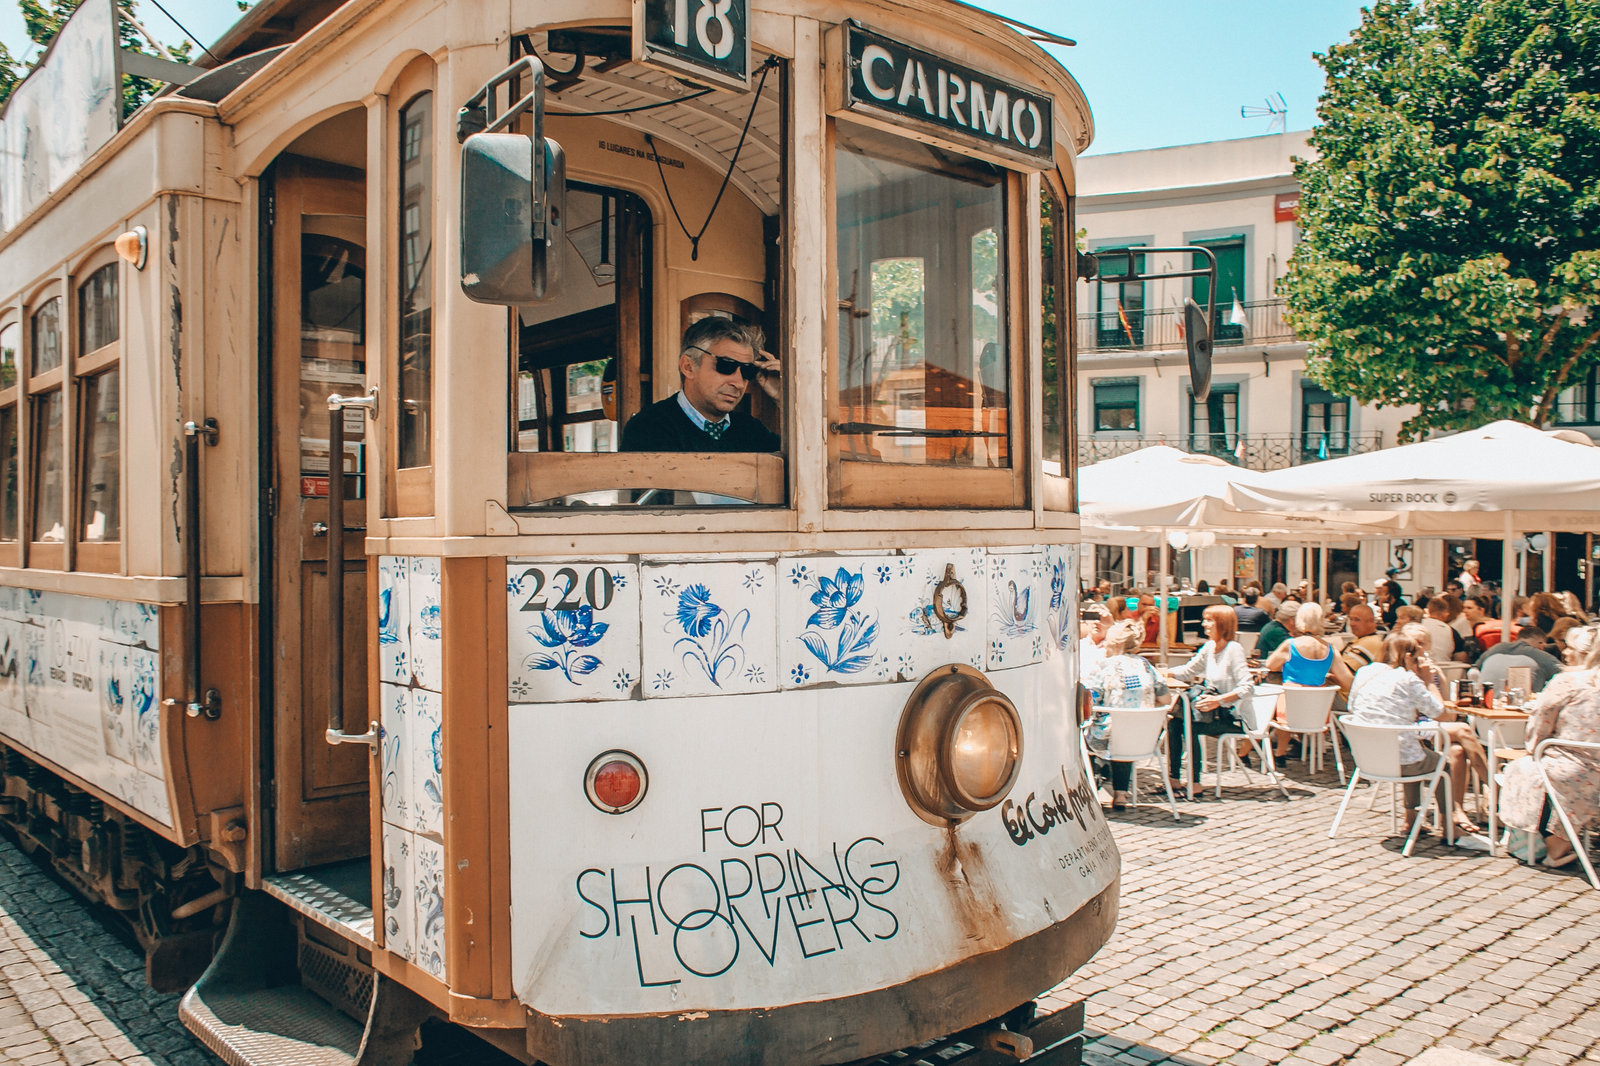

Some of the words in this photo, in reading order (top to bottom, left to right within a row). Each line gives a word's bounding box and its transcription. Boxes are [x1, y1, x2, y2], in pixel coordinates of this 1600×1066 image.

[674, 0, 735, 59] 18
[861, 43, 1042, 149] CARMO
[606, 142, 635, 157] LUGARES
[636, 149, 645, 158] NA
[1369, 492, 1404, 503] SUPER
[1406, 492, 1438, 503] BOCK
[519, 566, 614, 612] 220
[700, 801, 784, 853] FOR
[1058, 836, 1098, 870] DEPARTMENT
[1079, 860, 1097, 878] GAIA
[576, 836, 900, 939] SHOPPING
[630, 876, 899, 988] LOVERS
